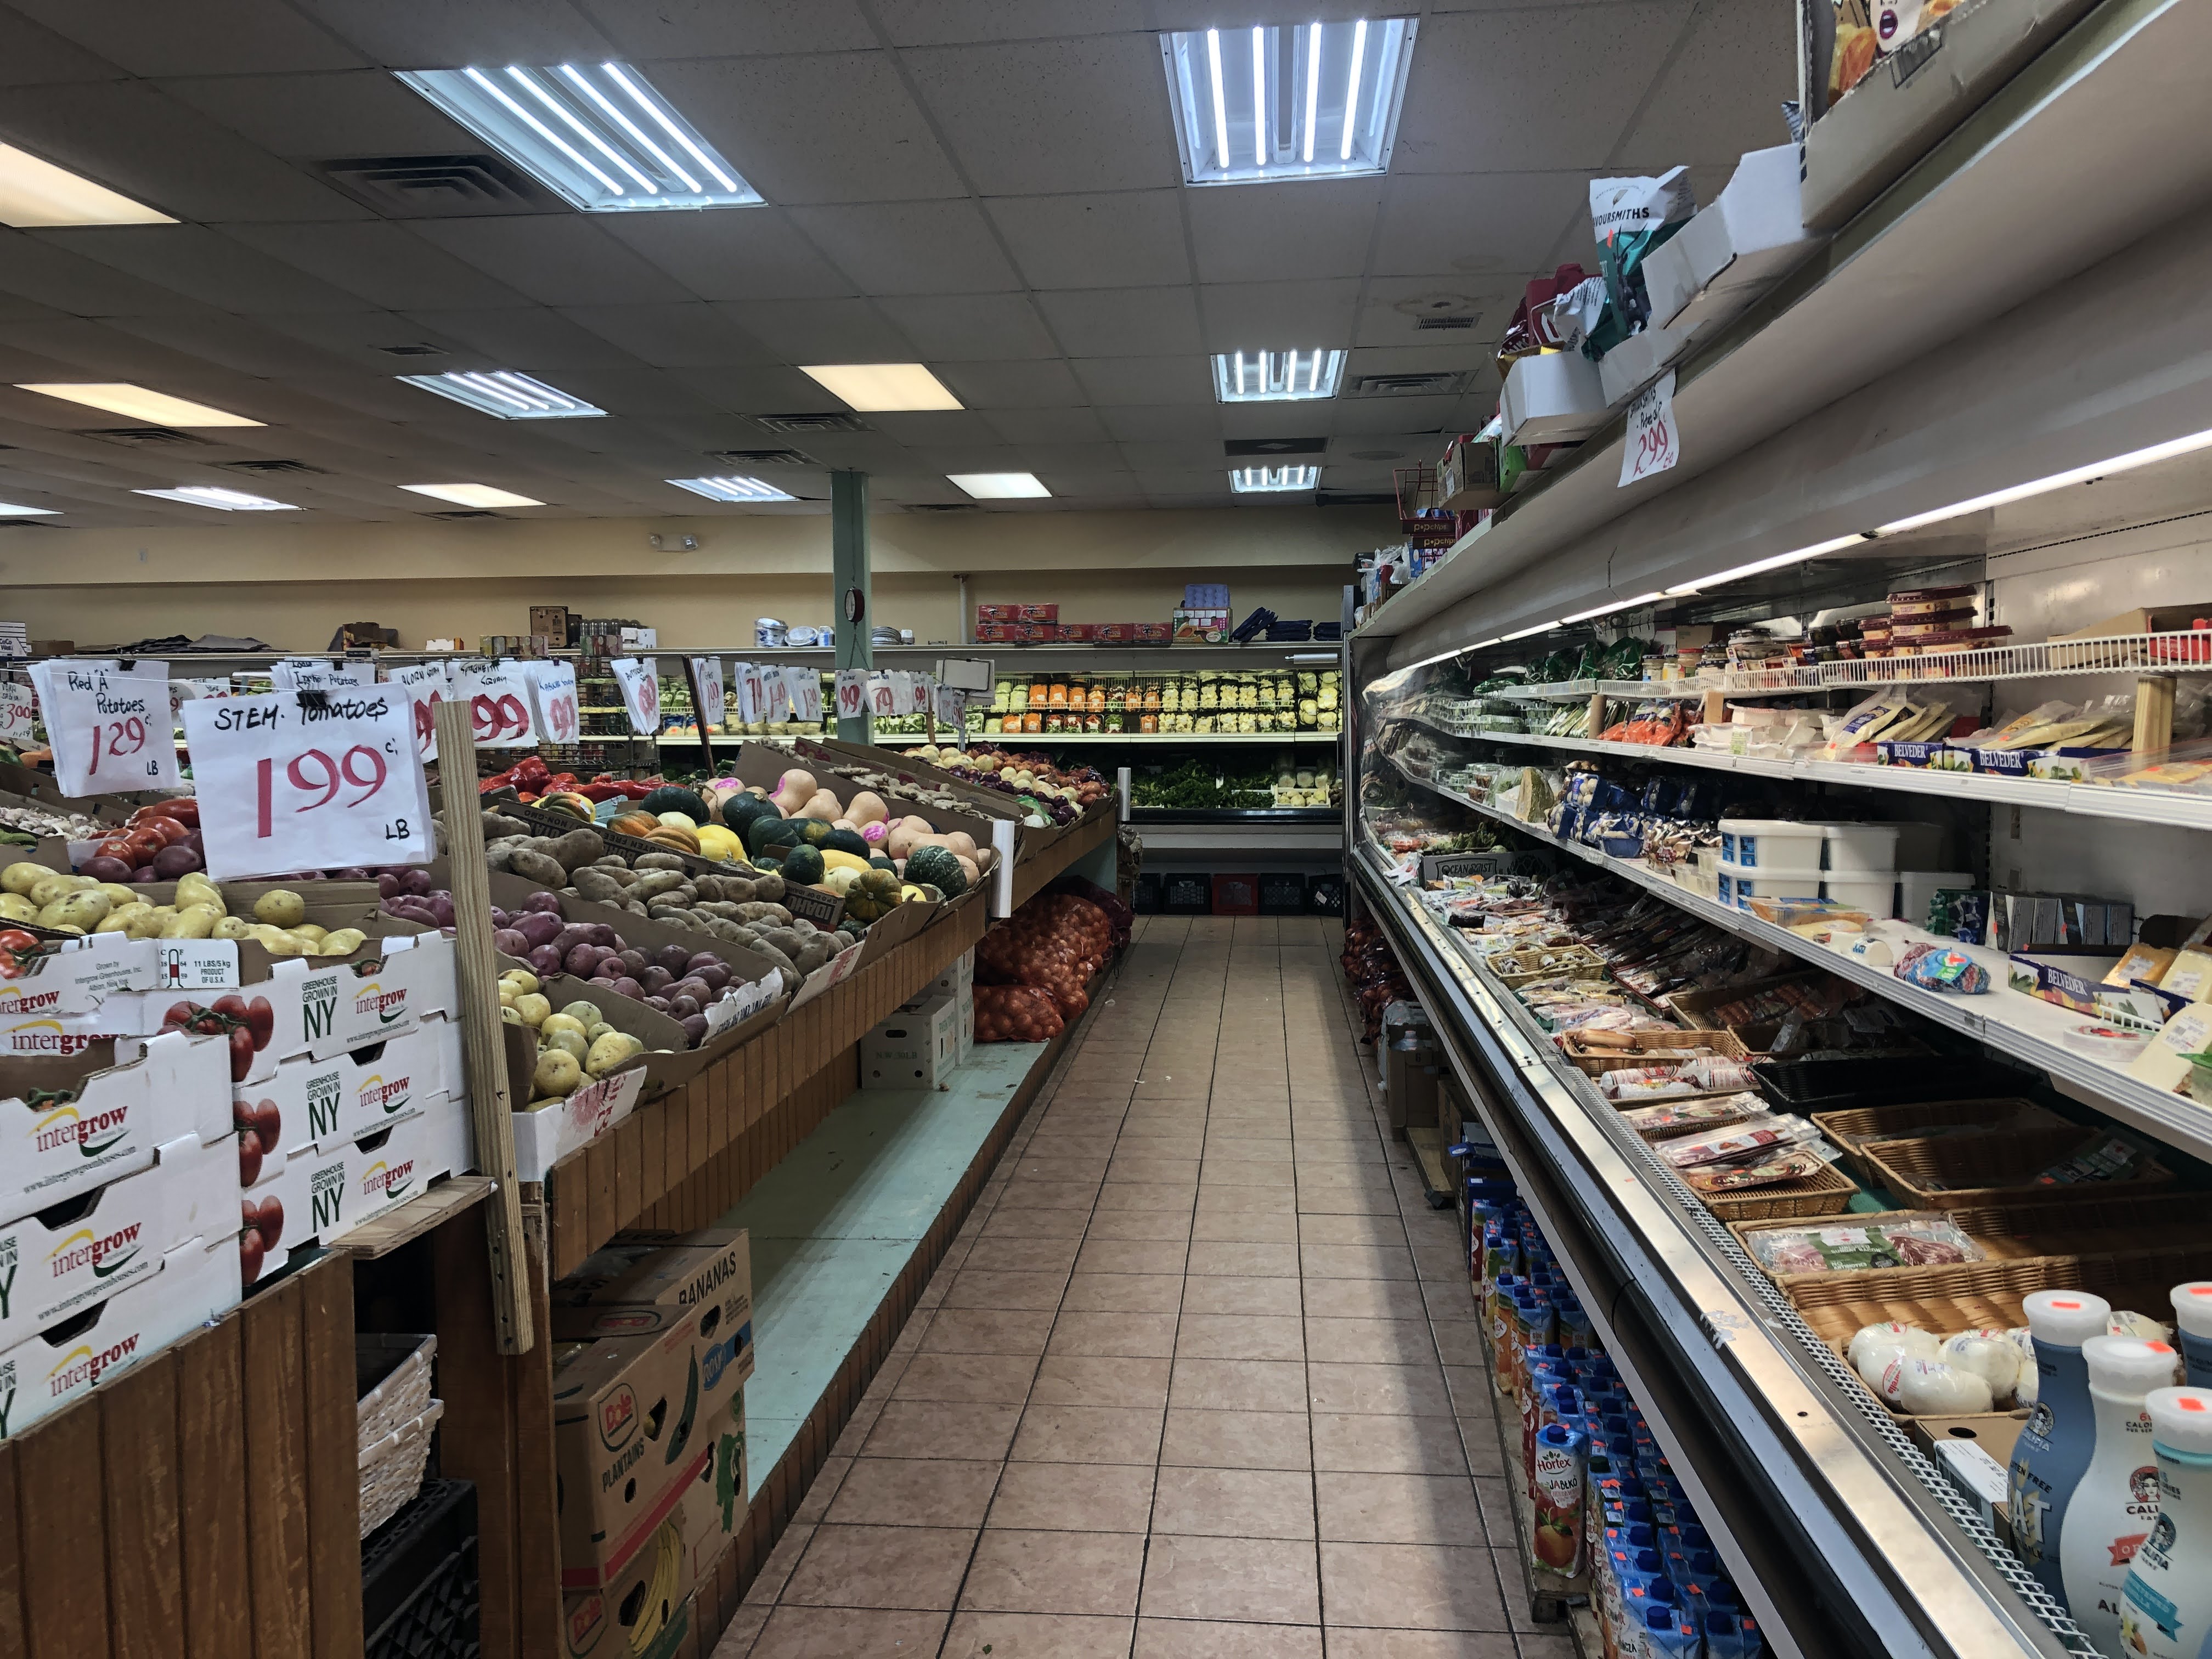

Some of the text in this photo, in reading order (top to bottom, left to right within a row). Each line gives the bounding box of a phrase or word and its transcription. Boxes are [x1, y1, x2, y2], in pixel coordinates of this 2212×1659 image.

[1633, 420, 1668, 478] 299
[1424, 538, 1456, 547] popchip
[67, 671, 93, 691] Red
[95, 692, 145, 714] Potatoes
[840, 684, 860, 713] 99
[471, 693, 529, 742] 99
[89, 716, 145, 776] 129
[1894, 744, 1927, 759] BELVEDER
[1979, 749, 2023, 769] BELVEDER
[146, 760, 159, 776] LB
[256, 744, 387, 839] 199
[386, 818, 410, 840] LB
[1442, 864, 1469, 875] OCEAN
[787, 895, 832, 921] IDAHO
[302, 975, 337, 991] GREENHOUSE
[302, 985, 338, 1003] GROWN IN
[2047, 968, 2088, 997] BELVEDER
[0, 990, 60, 1014] tergrow
[356, 988, 408, 1014] intergrow
[303, 996, 337, 1042] NY
[12, 1029, 119, 1055] intergr
[306, 1071, 340, 1090] GREENHOUSE
[307, 1080, 341, 1101] GROWN IN
[360, 1076, 410, 1107] intergrow
[36, 1105, 128, 1152] intergrow
[308, 1092, 340, 1141] NY
[311, 1161, 345, 1183] GREENHOUSE
[311, 1170, 346, 1194] GROWN IN
[363, 1159, 414, 1195] intergrow
[312, 1182, 345, 1233] NY
[52, 1222, 142, 1278] intergrow
[678, 1250, 737, 1305] BANANAS
[0, 1263, 17, 1319] Y
[50, 1333, 140, 1397] intergrow
[0, 1387, 16, 1440] Y
[605, 1393, 633, 1433] Dole
[601, 1437, 646, 1493] PLANTAINS
[1537, 1458, 1572, 1473] Hortex
[2027, 1471, 2053, 1494] FREE
[2012, 1488, 2053, 1545] AT
[2126, 1504, 2159, 1515] CALI
